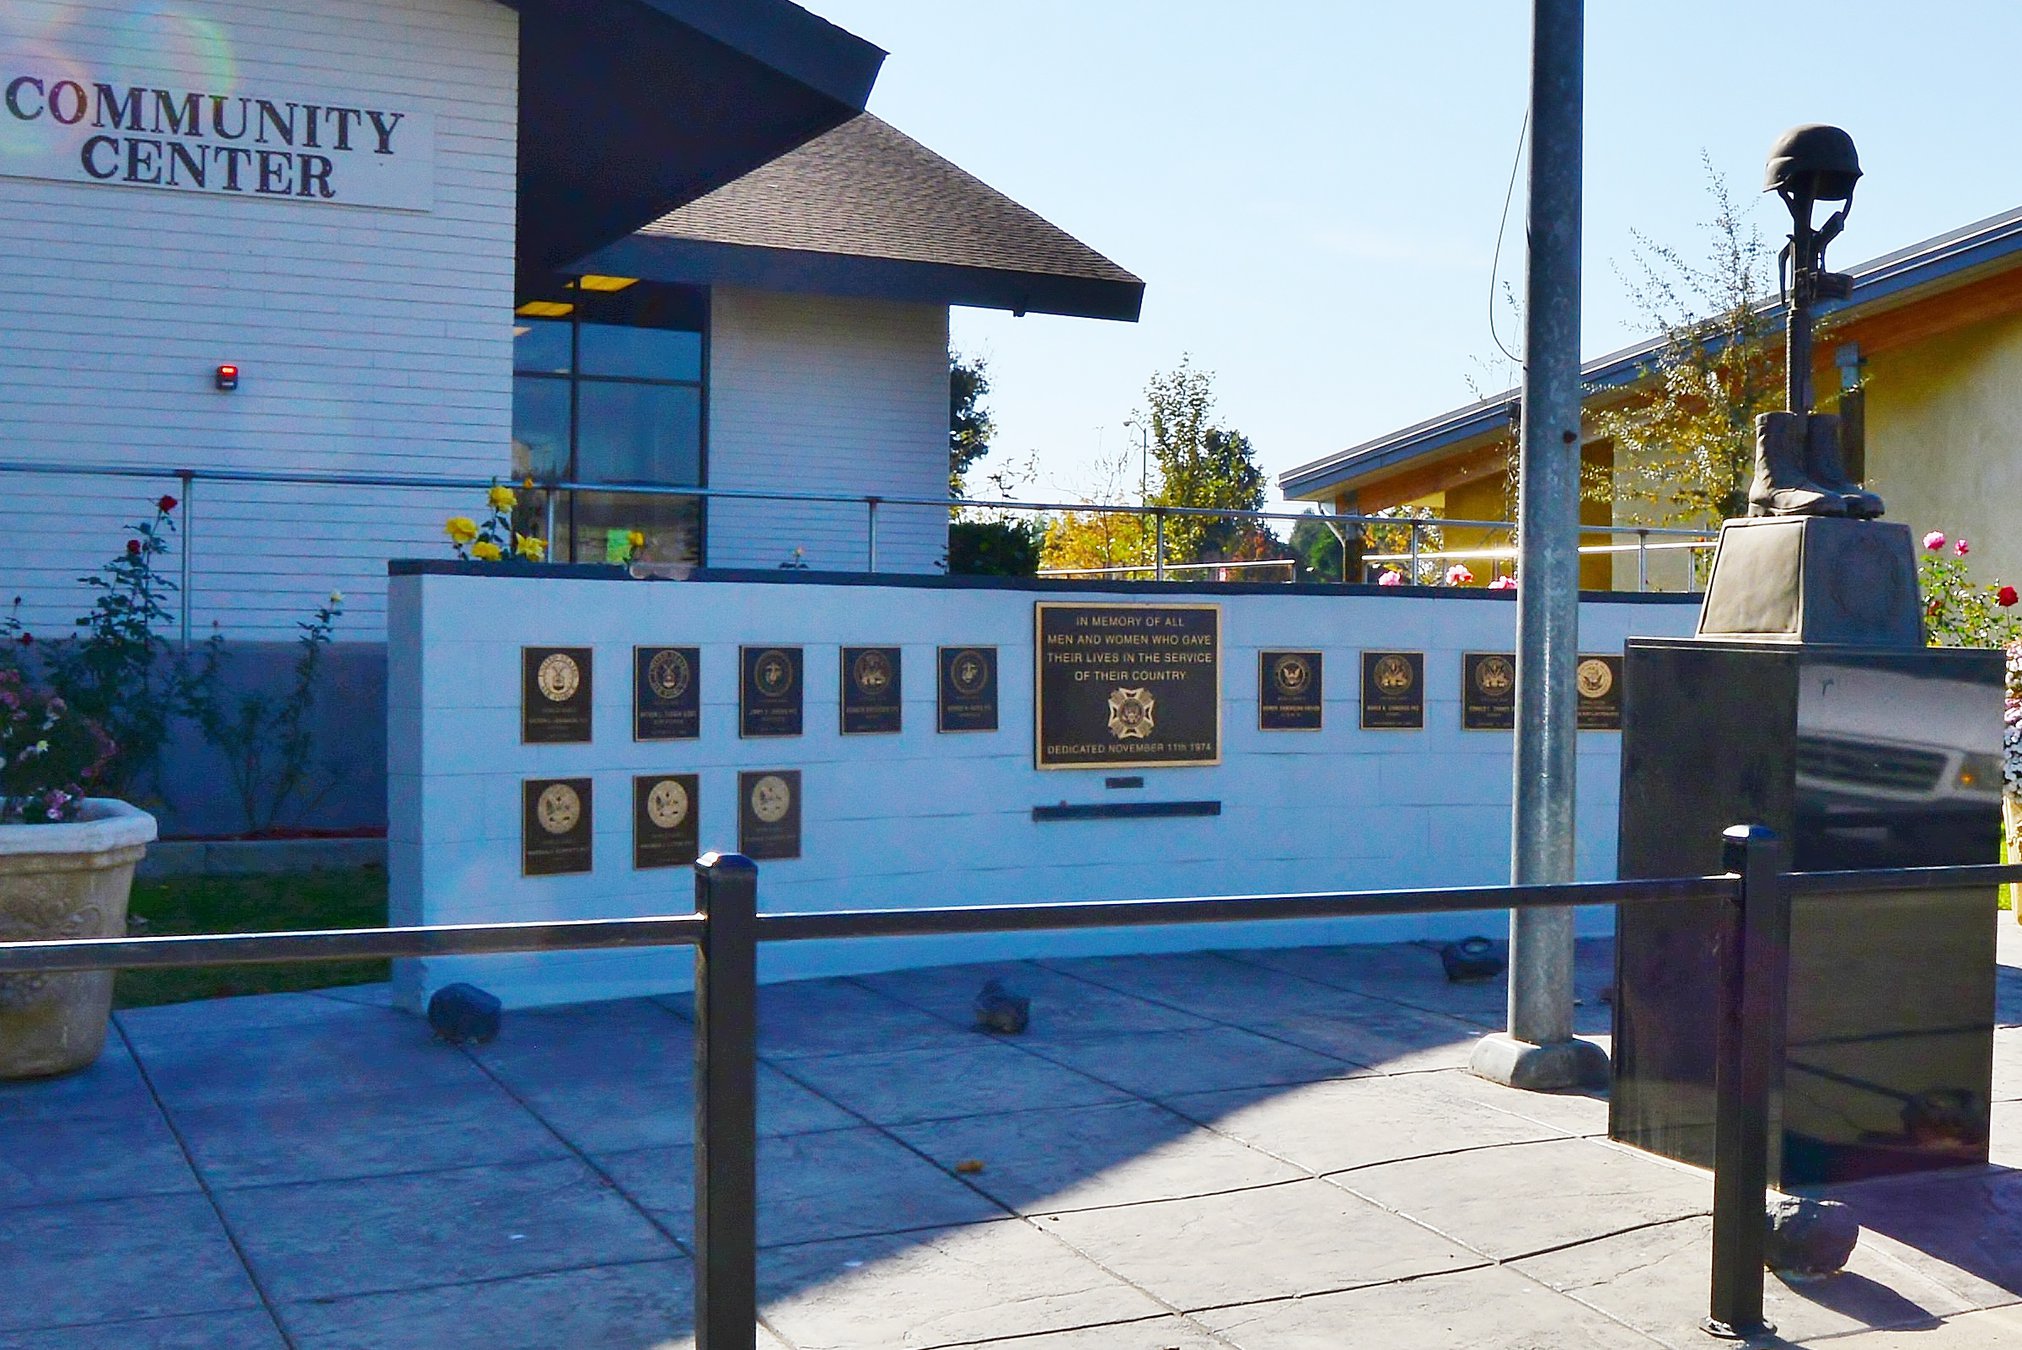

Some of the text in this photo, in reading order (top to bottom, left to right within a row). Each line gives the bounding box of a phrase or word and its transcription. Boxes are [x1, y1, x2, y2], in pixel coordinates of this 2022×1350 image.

[5, 75, 404, 154] COMMUNITY
[81, 135, 336, 198] CENTER
[1076, 617, 1184, 626] IN MEMORY OF ALL
[1048, 635, 1211, 645] MEN AND WOMEN WHO GAVE
[1047, 653, 1212, 663] THEIR LIVES IN THE SERVICE
[1075, 671, 1186, 680] OF THEIR COUNTRY
[1048, 745, 1105, 754] DEDICATED
[1109, 744, 1164, 752] NOVEMBER
[1191, 743, 1211, 751] 1974
